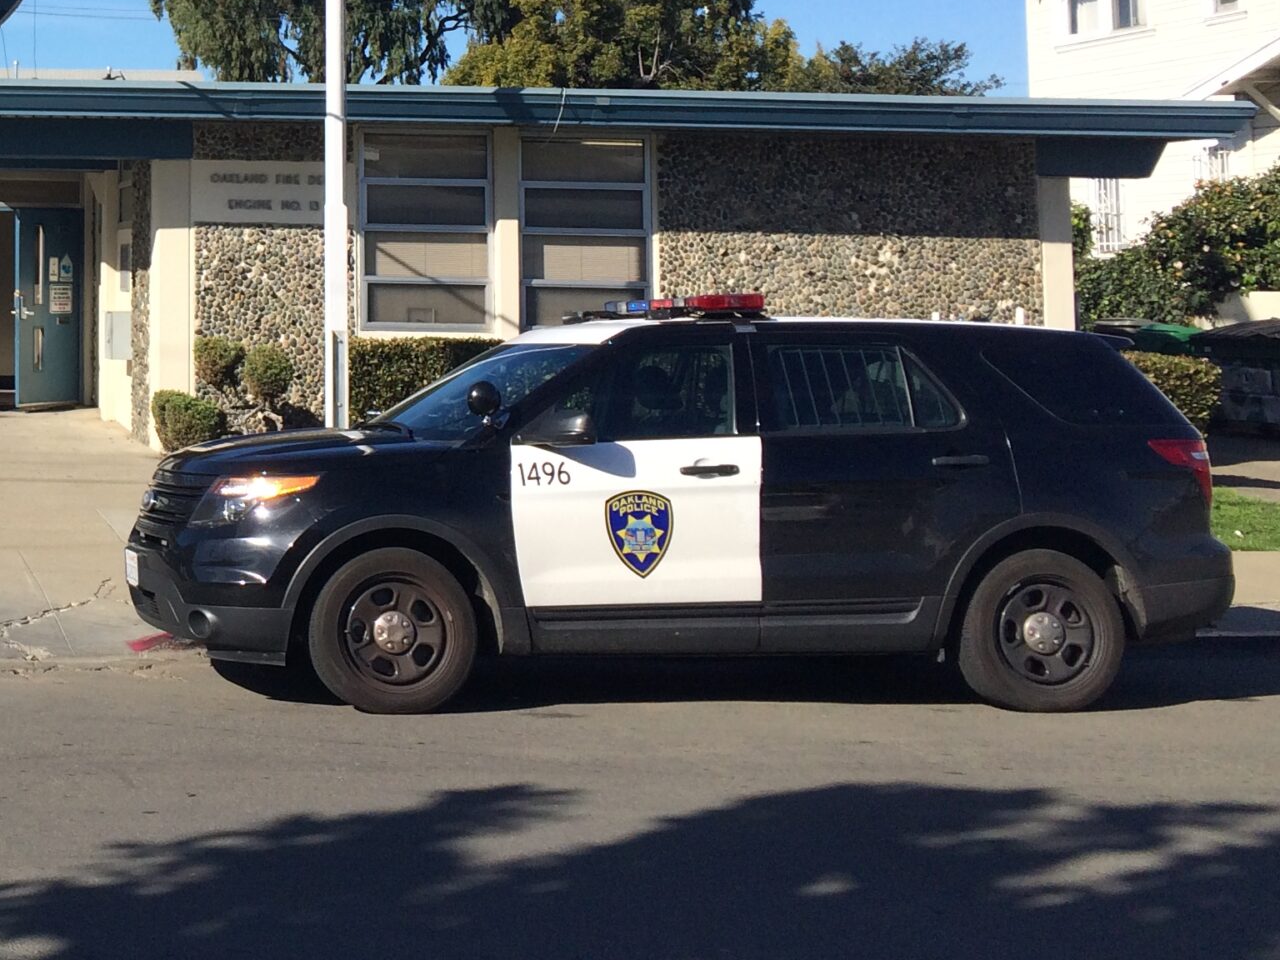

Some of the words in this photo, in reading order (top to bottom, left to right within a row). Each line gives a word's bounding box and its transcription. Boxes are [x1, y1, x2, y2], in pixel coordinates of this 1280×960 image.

[210, 173, 268, 184] OAKLAND
[275, 174, 301, 185] FIRE
[307, 174, 324, 186] DE
[228, 199, 272, 210] ENGINE
[517, 461, 571, 487] 1496
[612, 494, 665, 512] OAKLAND
[619, 503, 660, 517] POLICE
